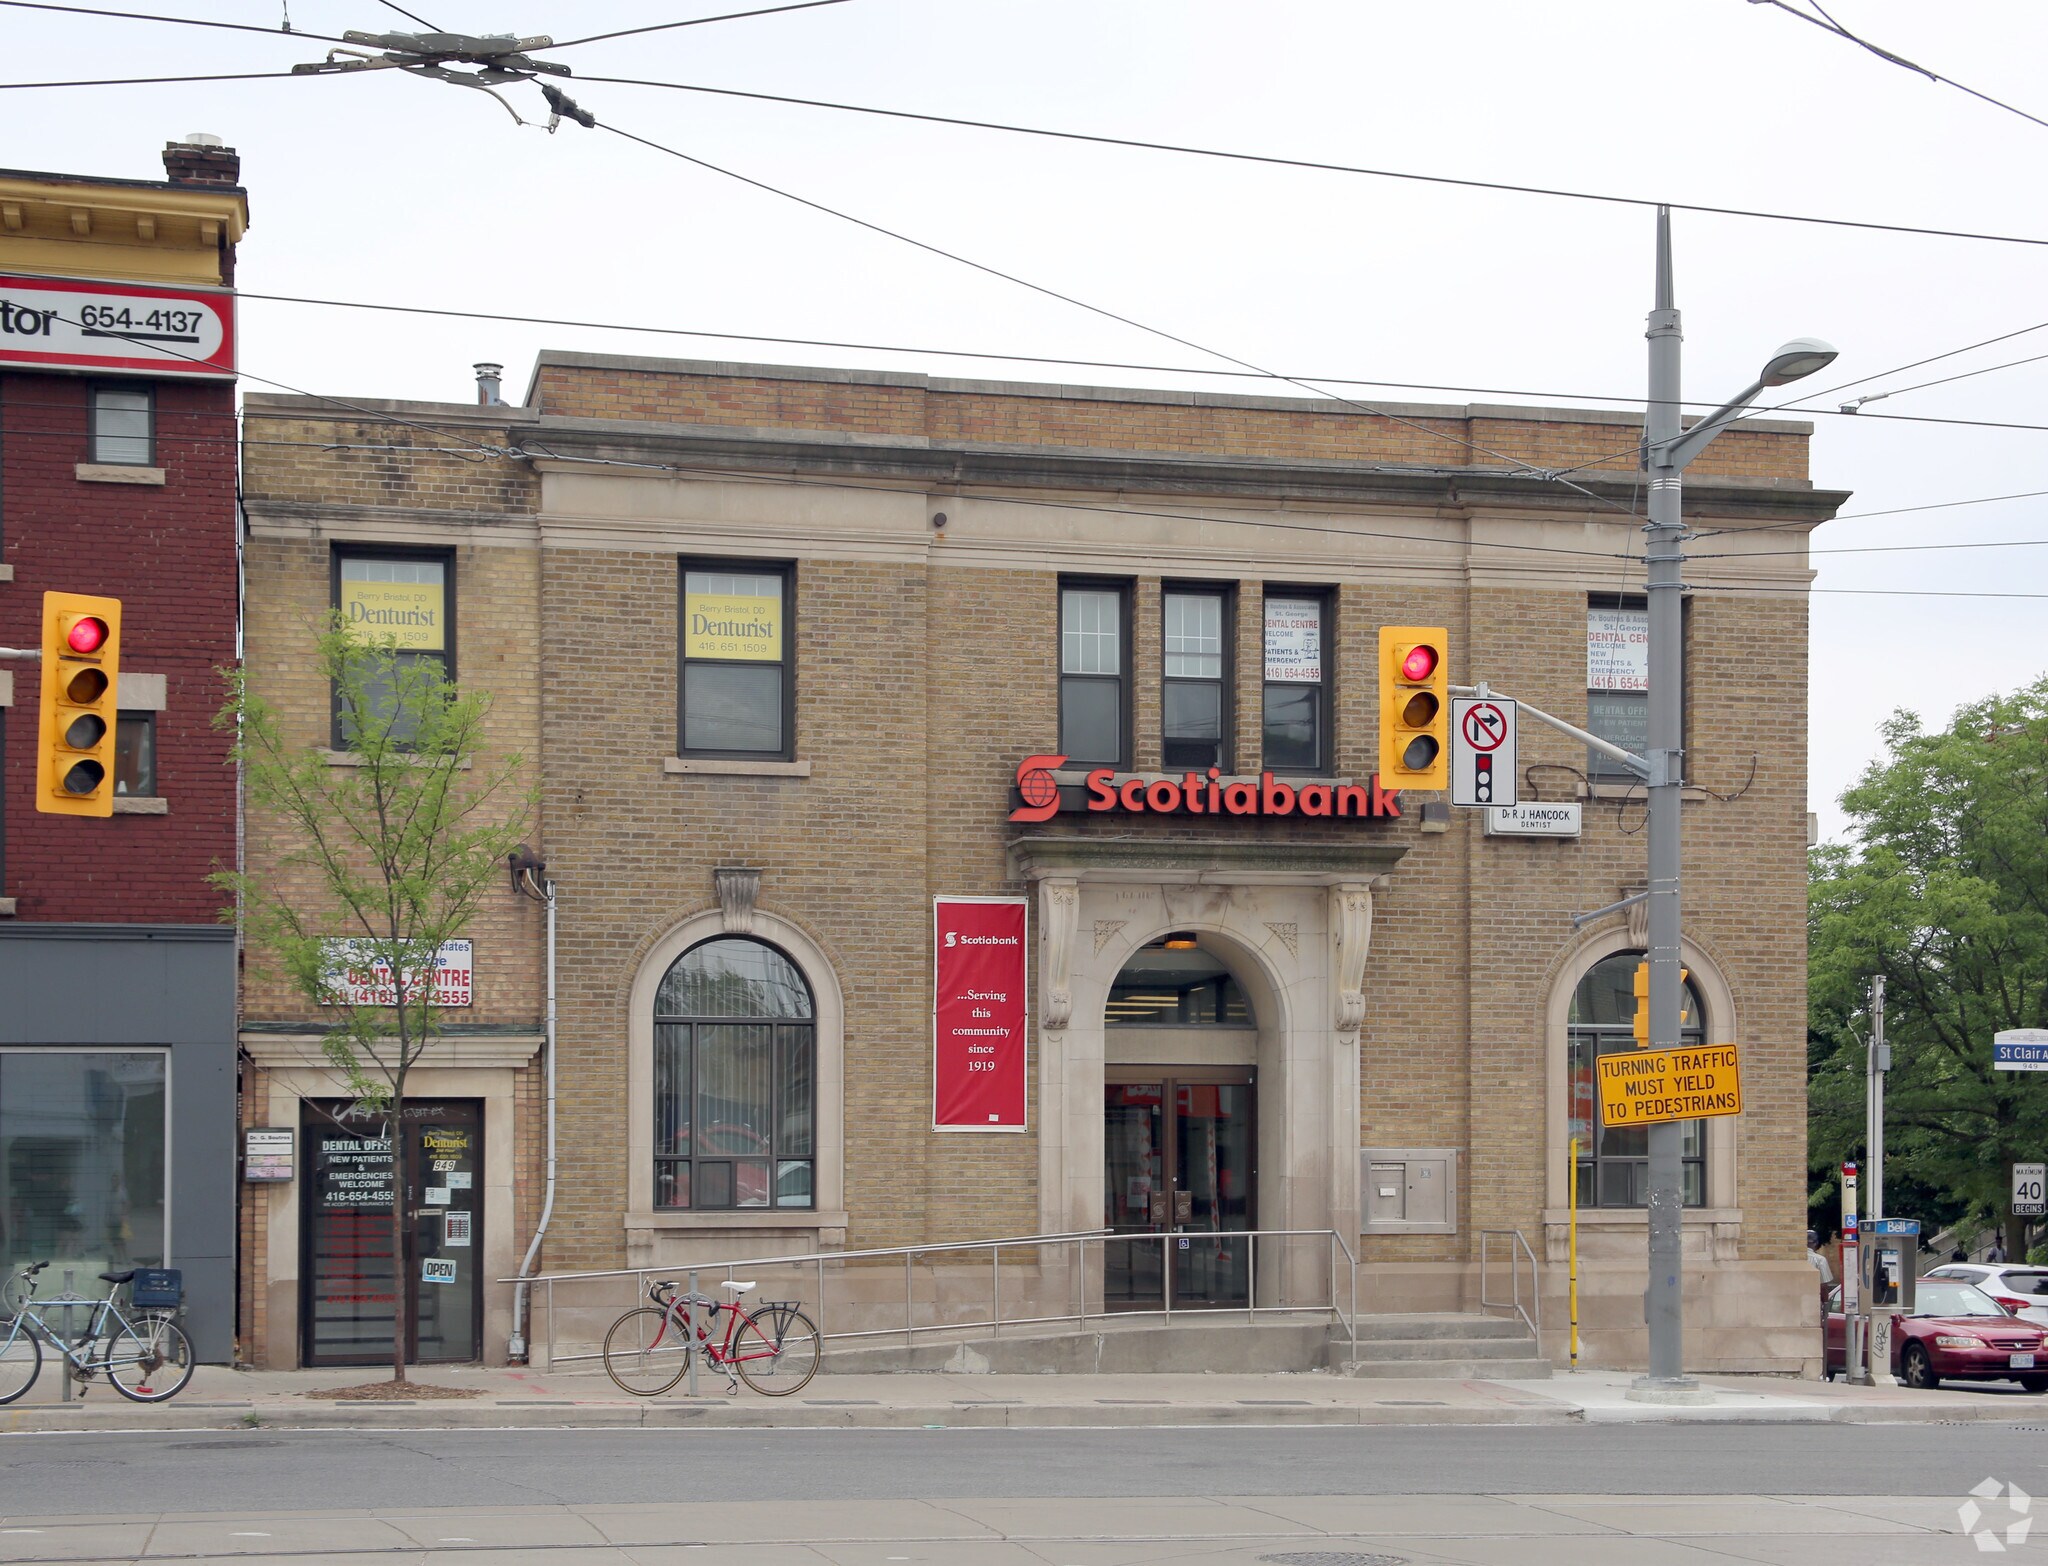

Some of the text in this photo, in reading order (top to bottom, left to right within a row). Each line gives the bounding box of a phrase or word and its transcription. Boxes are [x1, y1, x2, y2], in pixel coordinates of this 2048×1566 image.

[81, 305, 203, 333] 654-4137
[349, 601, 435, 626] Denturist
[700, 605, 721, 614] Berry
[692, 614, 773, 638] Denturist
[1291, 620, 1318, 629] CENTRE
[1619, 624, 1648, 633] Georg
[1589, 632, 1626, 642] DENTAL
[1285, 668, 1320, 678] 654-4555
[1591, 676, 1616, 688] (416)
[1593, 705, 1648, 715] DENTAL OFFI
[1086, 767, 1402, 817] Scotiabank
[1502, 809, 1570, 820] Dr R J HANCOCK
[960, 935, 1018, 945] Scotiabank
[972, 1007, 991, 1018] this
[952, 1026, 1010, 1038] community
[968, 1044, 994, 1054] since
[2000, 1046, 2011, 1059] St
[2014, 1047, 2041, 1059] Clair
[968, 1061, 995, 1071] 1919
[1602, 1051, 1735, 1078] TURNING TRAFFIC
[1625, 1074, 1715, 1096] MUST YIELD
[1608, 1093, 1736, 1118] TO PEDESTRIANS
[322, 1140, 361, 1151] DENTAL
[424, 1136, 468, 1148] Denturist
[434, 1160, 454, 1170] 949
[329, 1172, 394, 1180] EMERGENCIES
[2016, 1181, 2041, 1200] 40
[2015, 1204, 2042, 1213] BEGINS
[1887, 1220, 1906, 1233] Bell
[426, 1262, 453, 1277] OPEN
